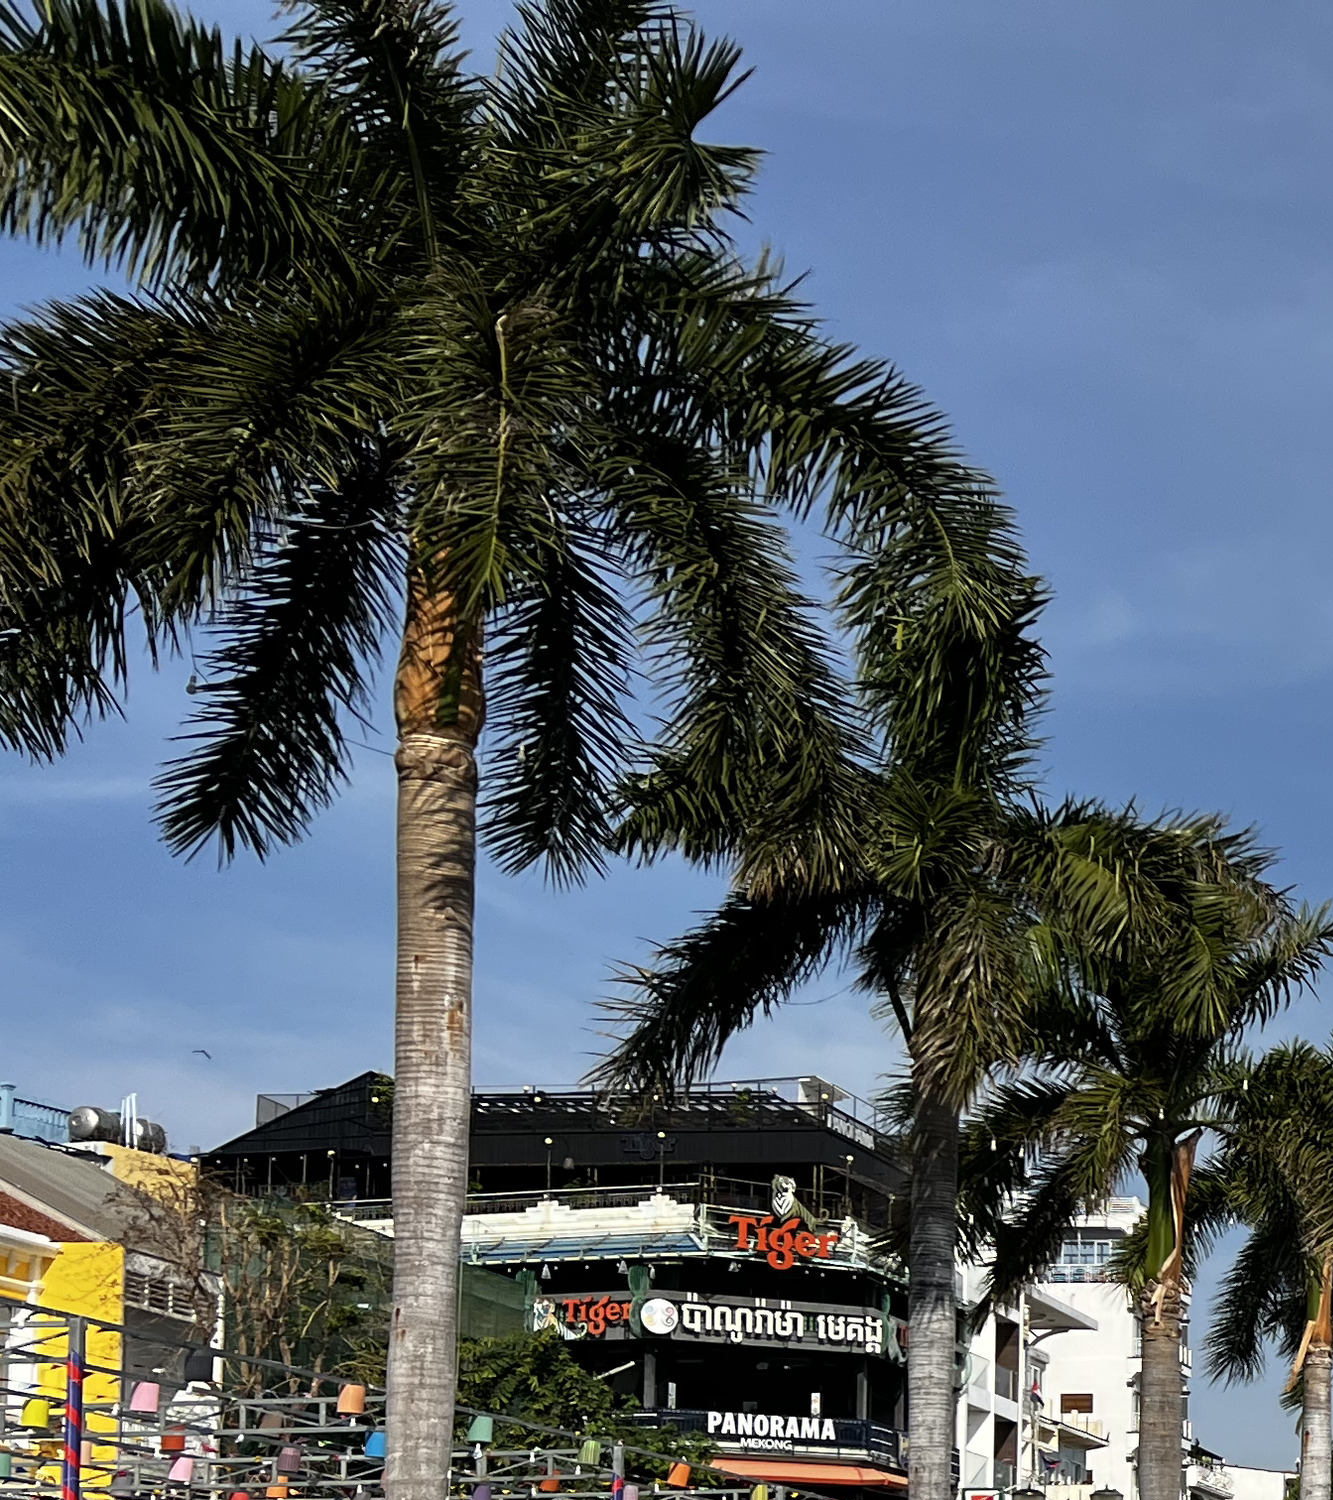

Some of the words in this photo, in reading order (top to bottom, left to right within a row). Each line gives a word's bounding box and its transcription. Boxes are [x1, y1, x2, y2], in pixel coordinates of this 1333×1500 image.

[729, 1215, 839, 1270] Tiger
[563, 1295, 631, 1335] Tiger
[707, 1411, 836, 1440] PANORAMA
[740, 1437, 793, 1450] MEKONG
